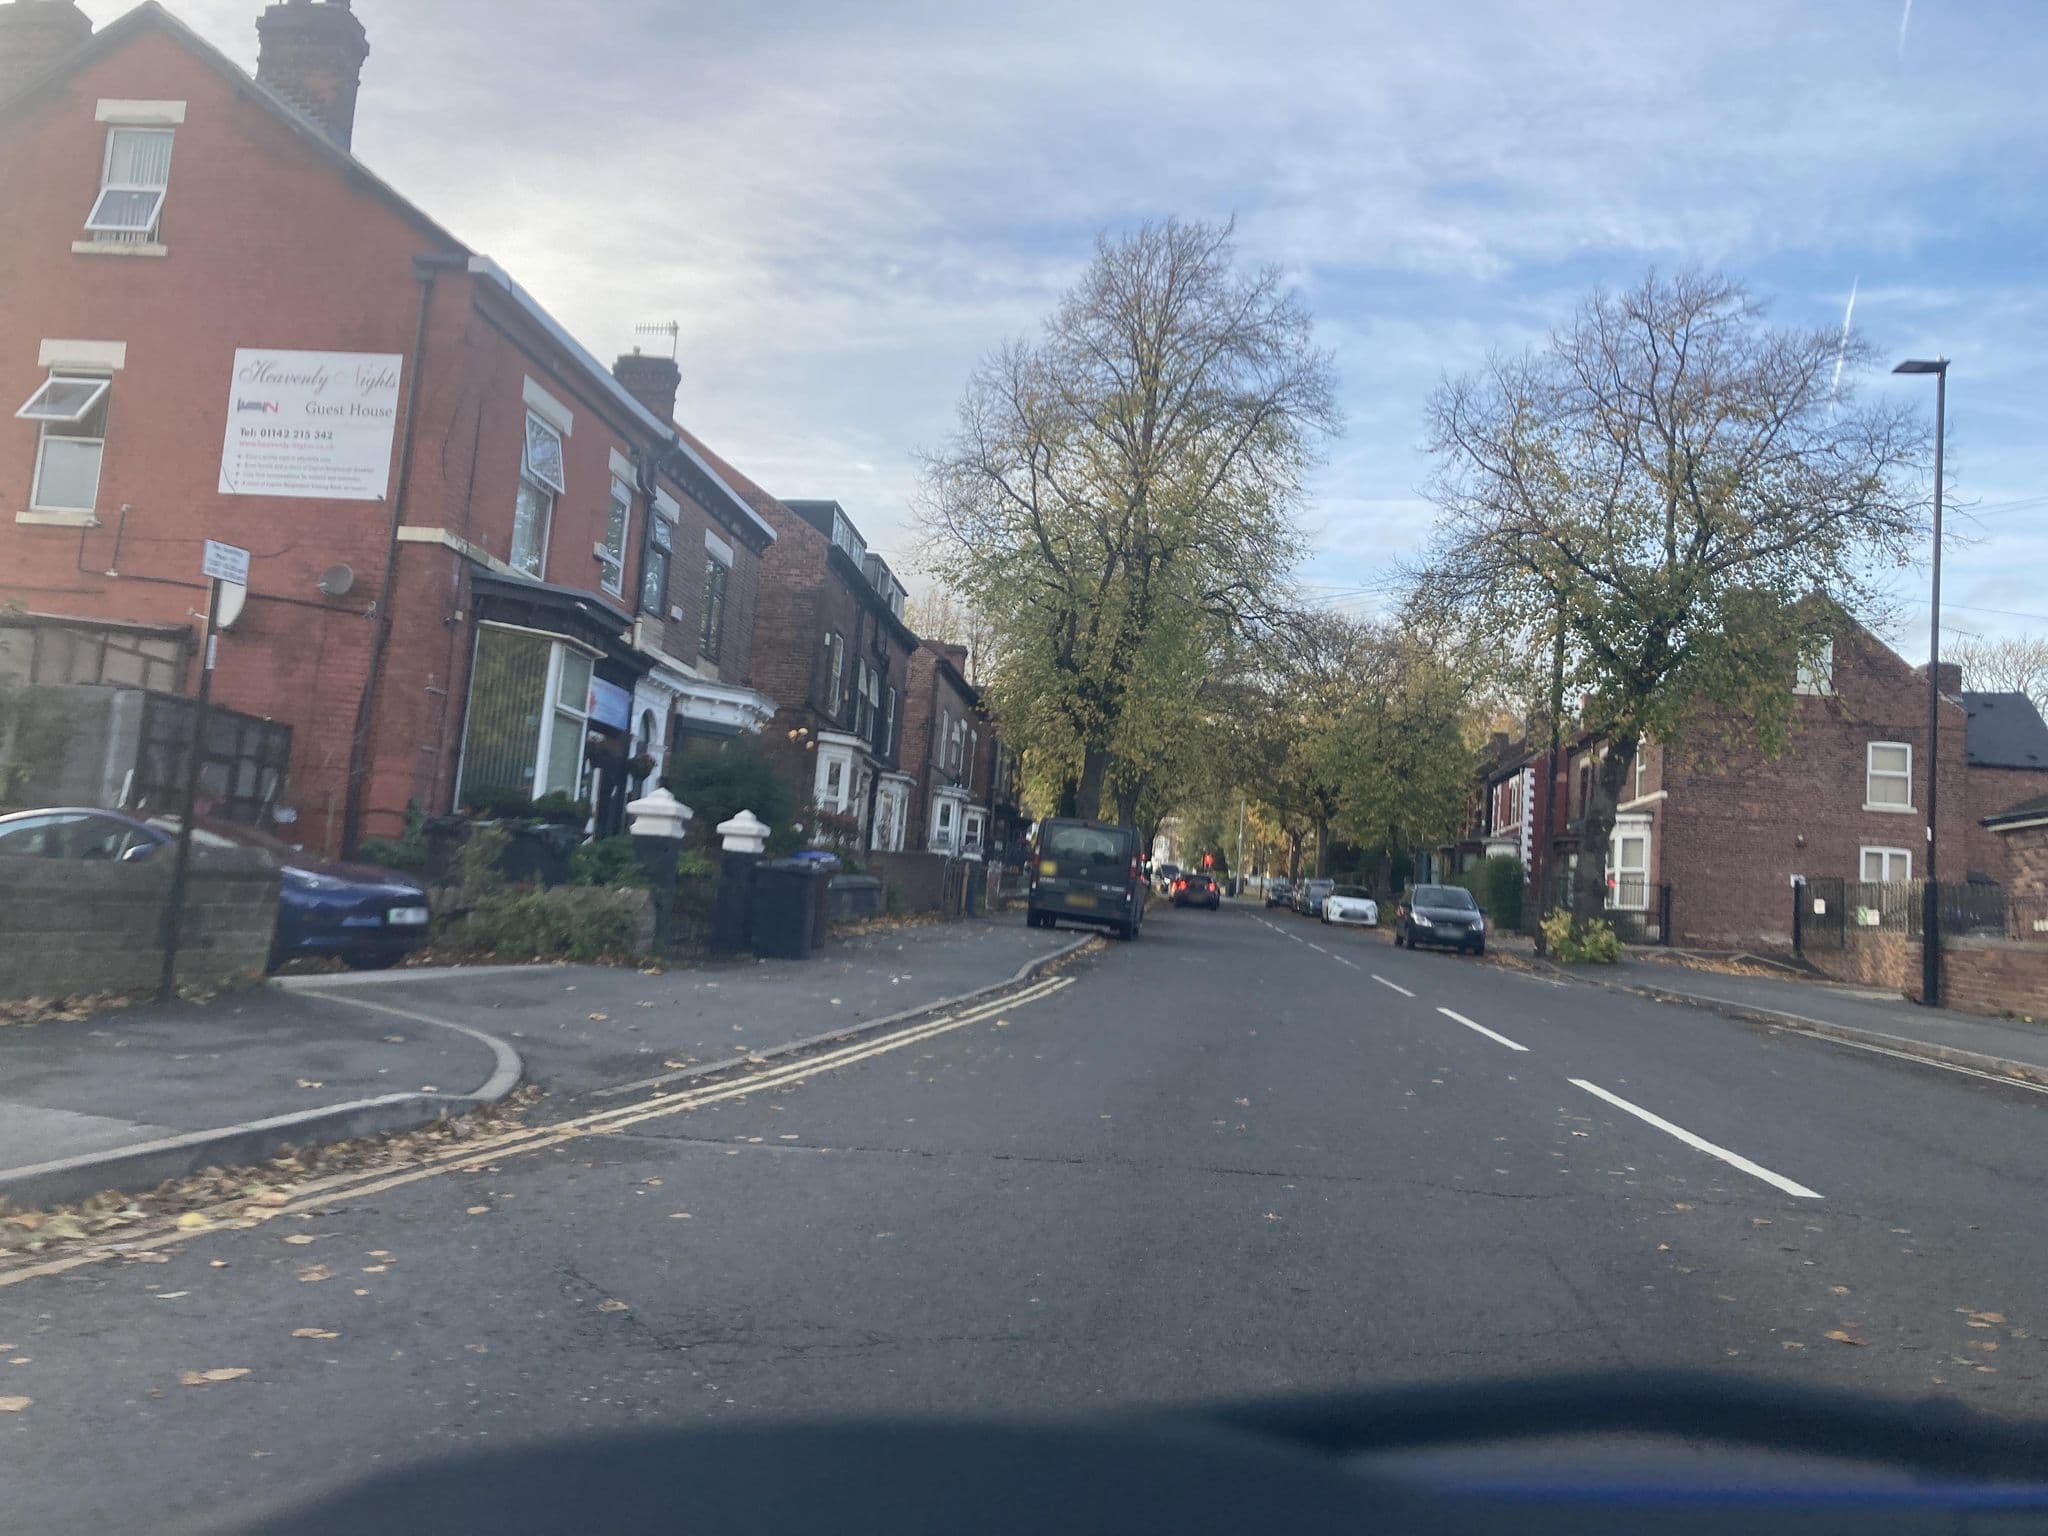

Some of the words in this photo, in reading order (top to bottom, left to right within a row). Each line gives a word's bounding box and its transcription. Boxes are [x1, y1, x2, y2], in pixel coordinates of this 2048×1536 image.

[239, 360, 329, 396] Heavenly
[335, 363, 397, 397] Nights
[305, 400, 344, 417] Guest
[350, 402, 393, 418] House
[240, 426, 257, 438] Tel:
[260, 428, 290, 439] 01142
[293, 430, 311, 440] 215
[314, 431, 333, 440] 342
